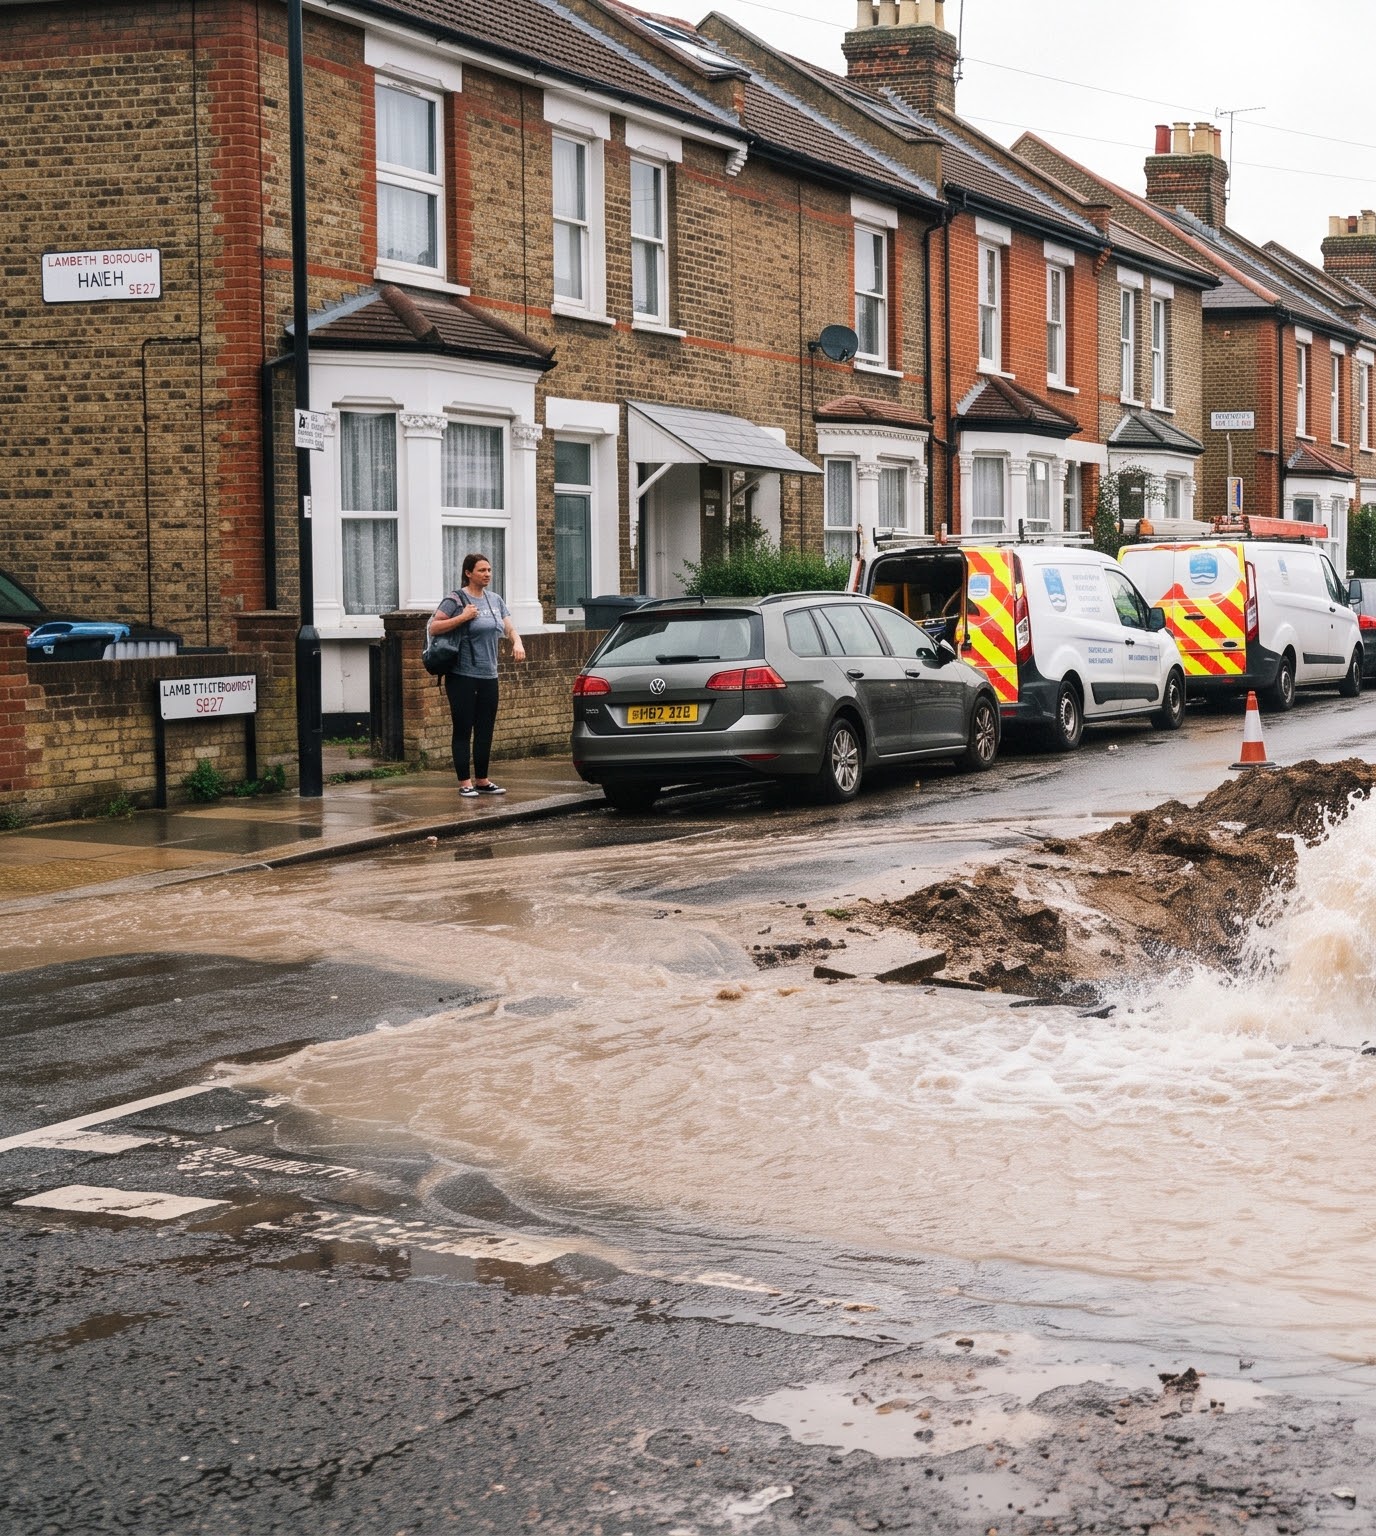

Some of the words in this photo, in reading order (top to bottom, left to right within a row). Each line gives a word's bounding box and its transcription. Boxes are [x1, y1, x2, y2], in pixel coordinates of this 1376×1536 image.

[48, 255, 97, 267] LAMBETH
[102, 252, 153, 265] BOROUGH
[128, 283, 156, 295] SE27
